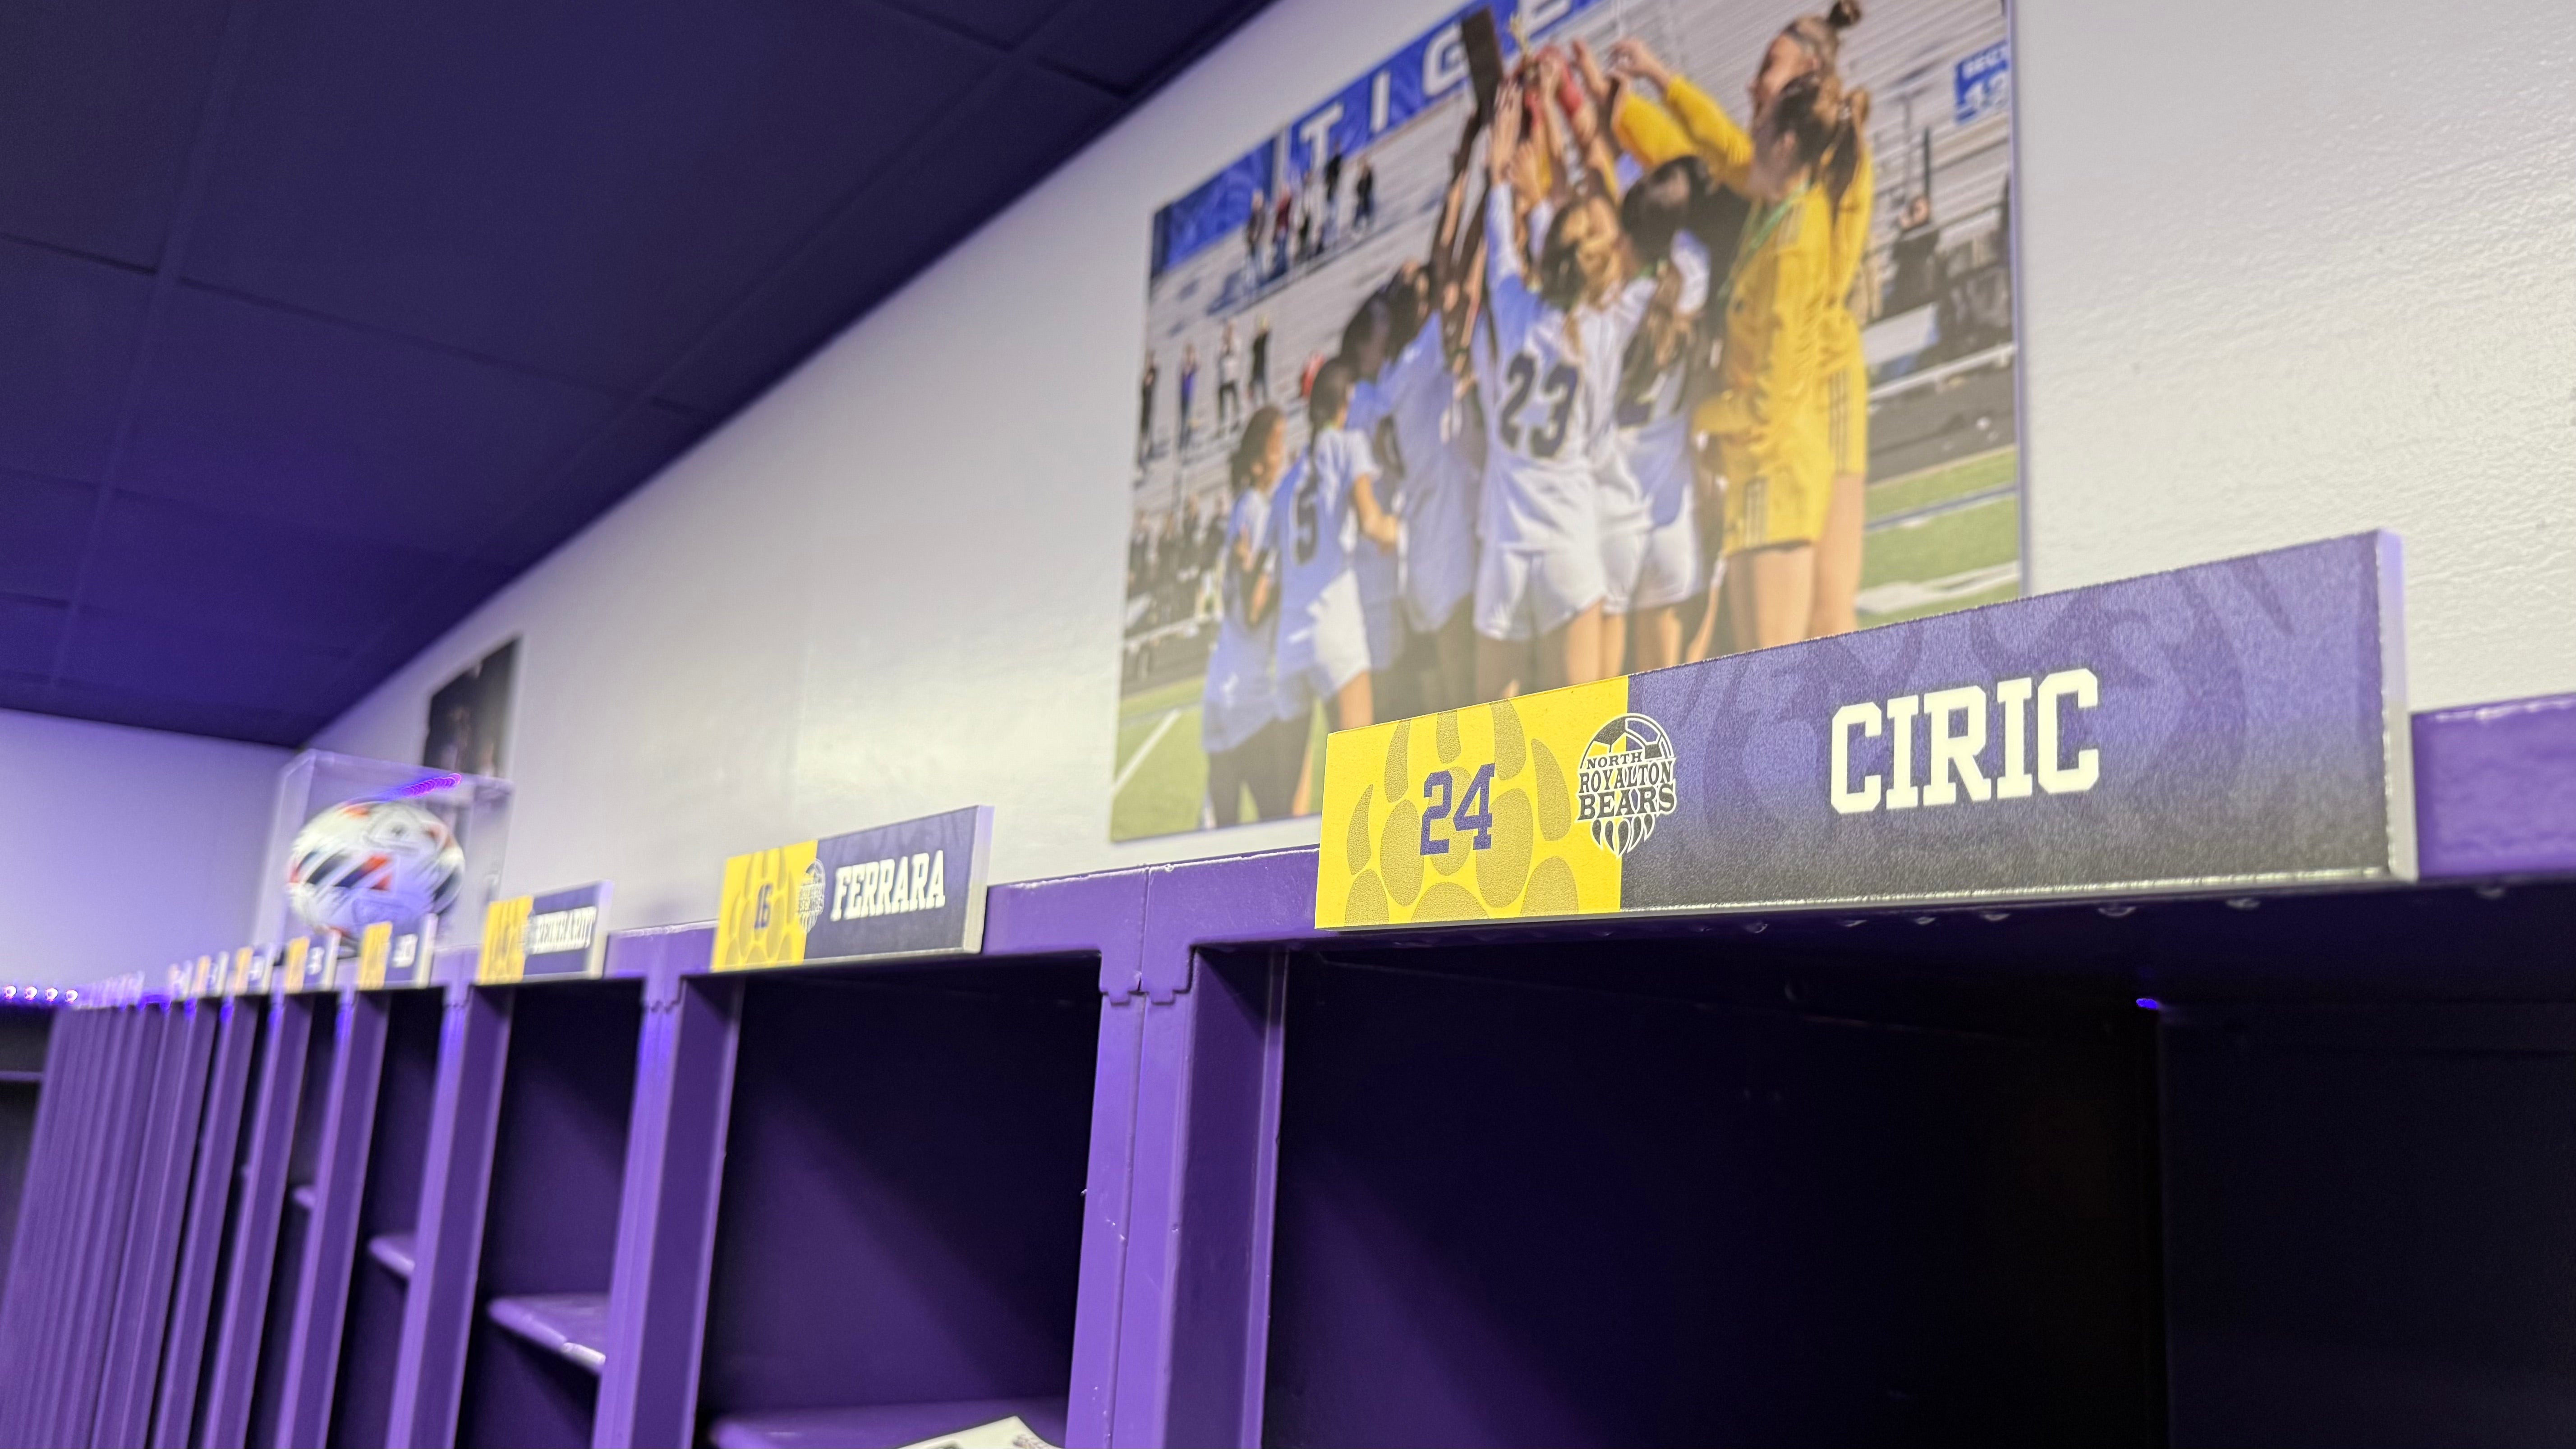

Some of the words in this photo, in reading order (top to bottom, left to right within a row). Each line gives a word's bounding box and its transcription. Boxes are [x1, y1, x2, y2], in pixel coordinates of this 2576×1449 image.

[1500, 353, 1578, 457] 23
[1295, 481, 1319, 565] 5
[1579, 760, 1673, 793] ROYALTON
[1587, 751, 1643, 769] NORTH
[1831, 668, 2099, 814] CIRIC
[1420, 763, 1495, 856] 24
[1577, 783, 1675, 821] BEARS
[754, 883, 773, 929] 16
[830, 850, 945, 921] FERRARA
